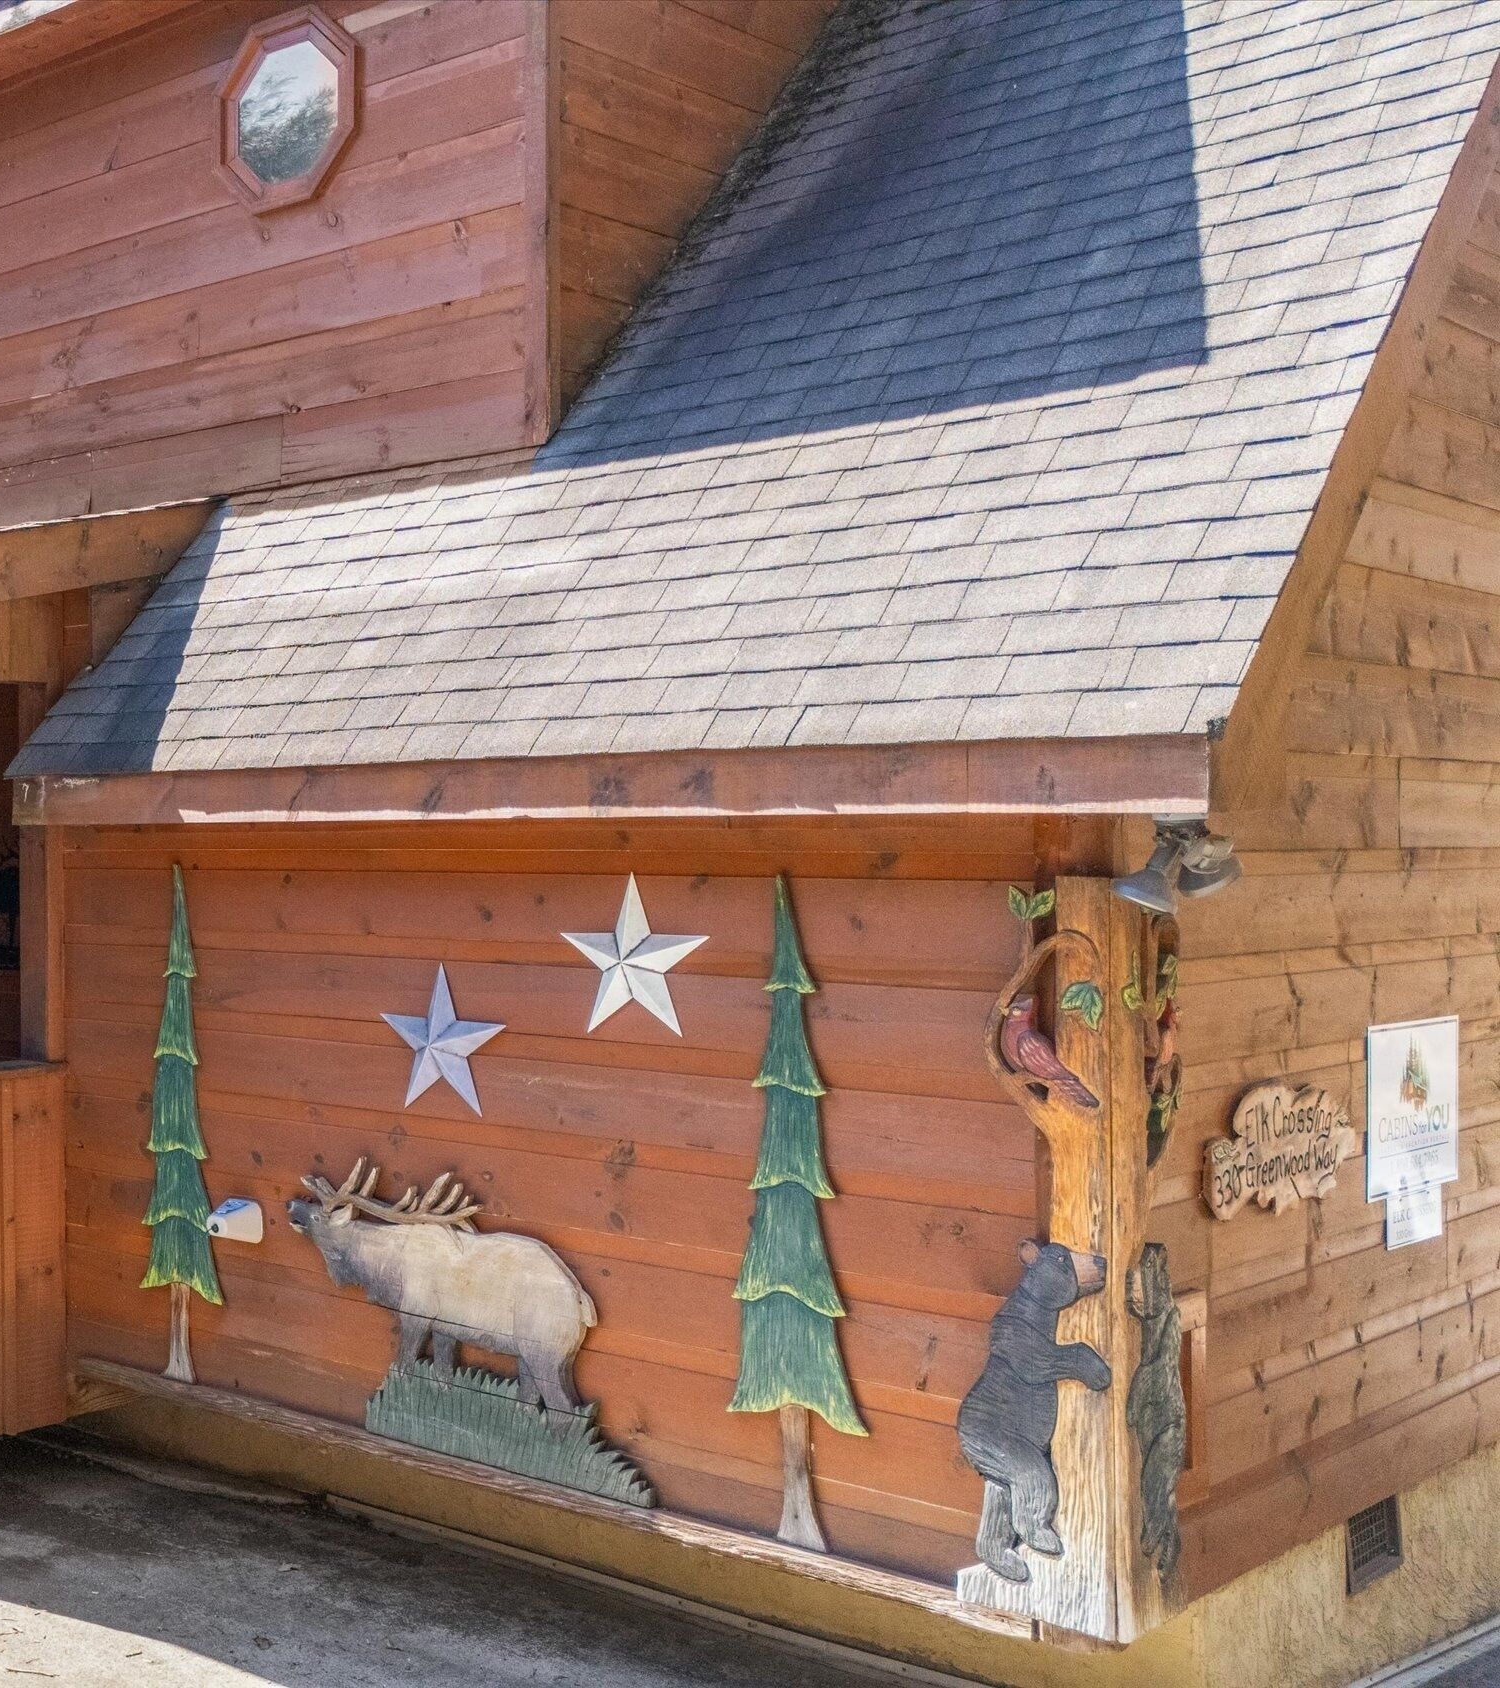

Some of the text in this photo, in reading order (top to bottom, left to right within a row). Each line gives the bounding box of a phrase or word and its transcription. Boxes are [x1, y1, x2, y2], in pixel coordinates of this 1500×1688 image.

[1245, 1096, 1332, 1148] Elk Crossing
[1379, 1114, 1418, 1143] CABINS
[1426, 1103, 1450, 1132] YOU
[1313, 1144, 1338, 1191] Way
